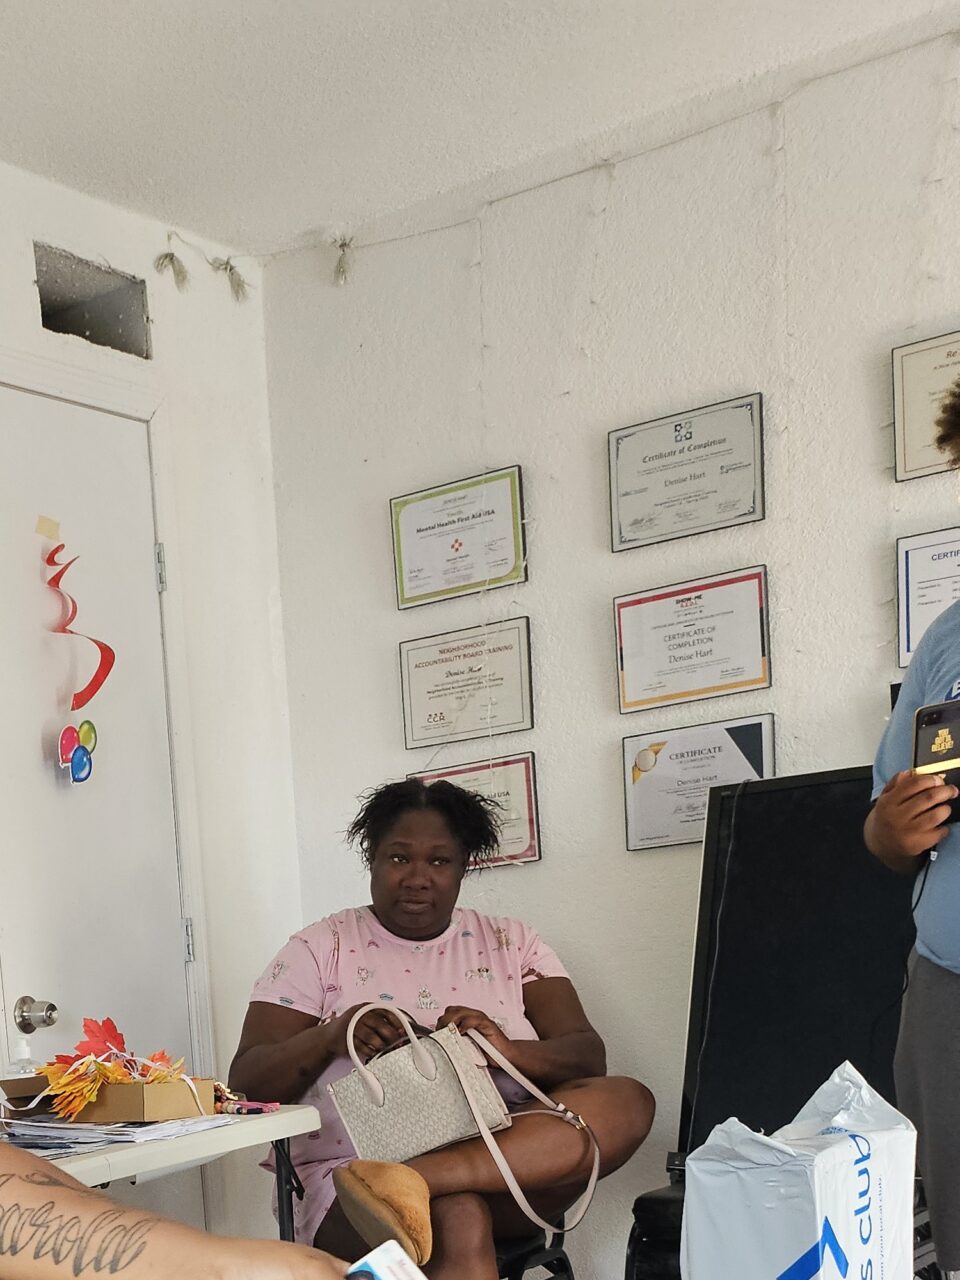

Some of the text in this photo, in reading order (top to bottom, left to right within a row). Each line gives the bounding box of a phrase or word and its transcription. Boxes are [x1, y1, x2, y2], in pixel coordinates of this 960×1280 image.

[642, 437, 727, 464] Certificate of Completion
[664, 471, 706, 488] Denise Hart
[416, 524, 436, 534] Mental
[437, 519, 456, 530] Health
[457, 516, 470, 524] First
[471, 512, 482, 520] Aid
[664, 626, 716, 643] CERTIFICATE OF
[438, 640, 487, 655] NEIGHBORHOOD
[668, 637, 713, 651] COMPLETION
[414, 655, 462, 669] ACCOUNTABILITY
[462, 650, 483, 660] BOARD
[669, 648, 713, 664] Denise Hart
[669, 745, 723, 761] CERTIFICATE
[848, 1133, 873, 1246] club
